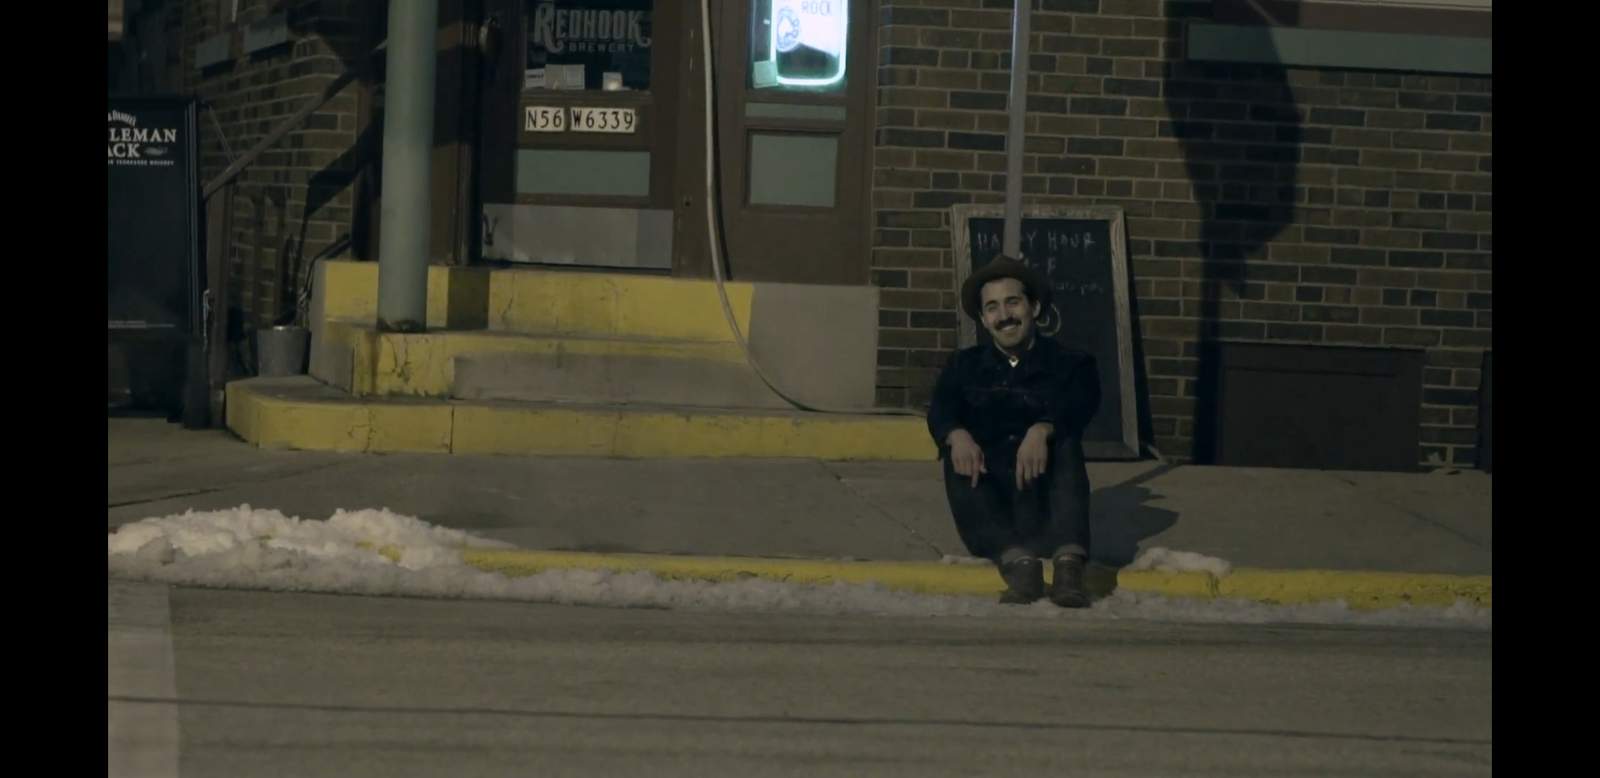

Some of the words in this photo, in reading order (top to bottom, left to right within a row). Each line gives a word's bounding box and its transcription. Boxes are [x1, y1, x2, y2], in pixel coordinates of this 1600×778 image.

[534, 2, 652, 53] REDHOOK
[568, 42, 634, 53] BREWERY
[527, 109, 563, 129] N56
[572, 110, 634, 130] W6339
[976, 230, 1038, 252] HAY
